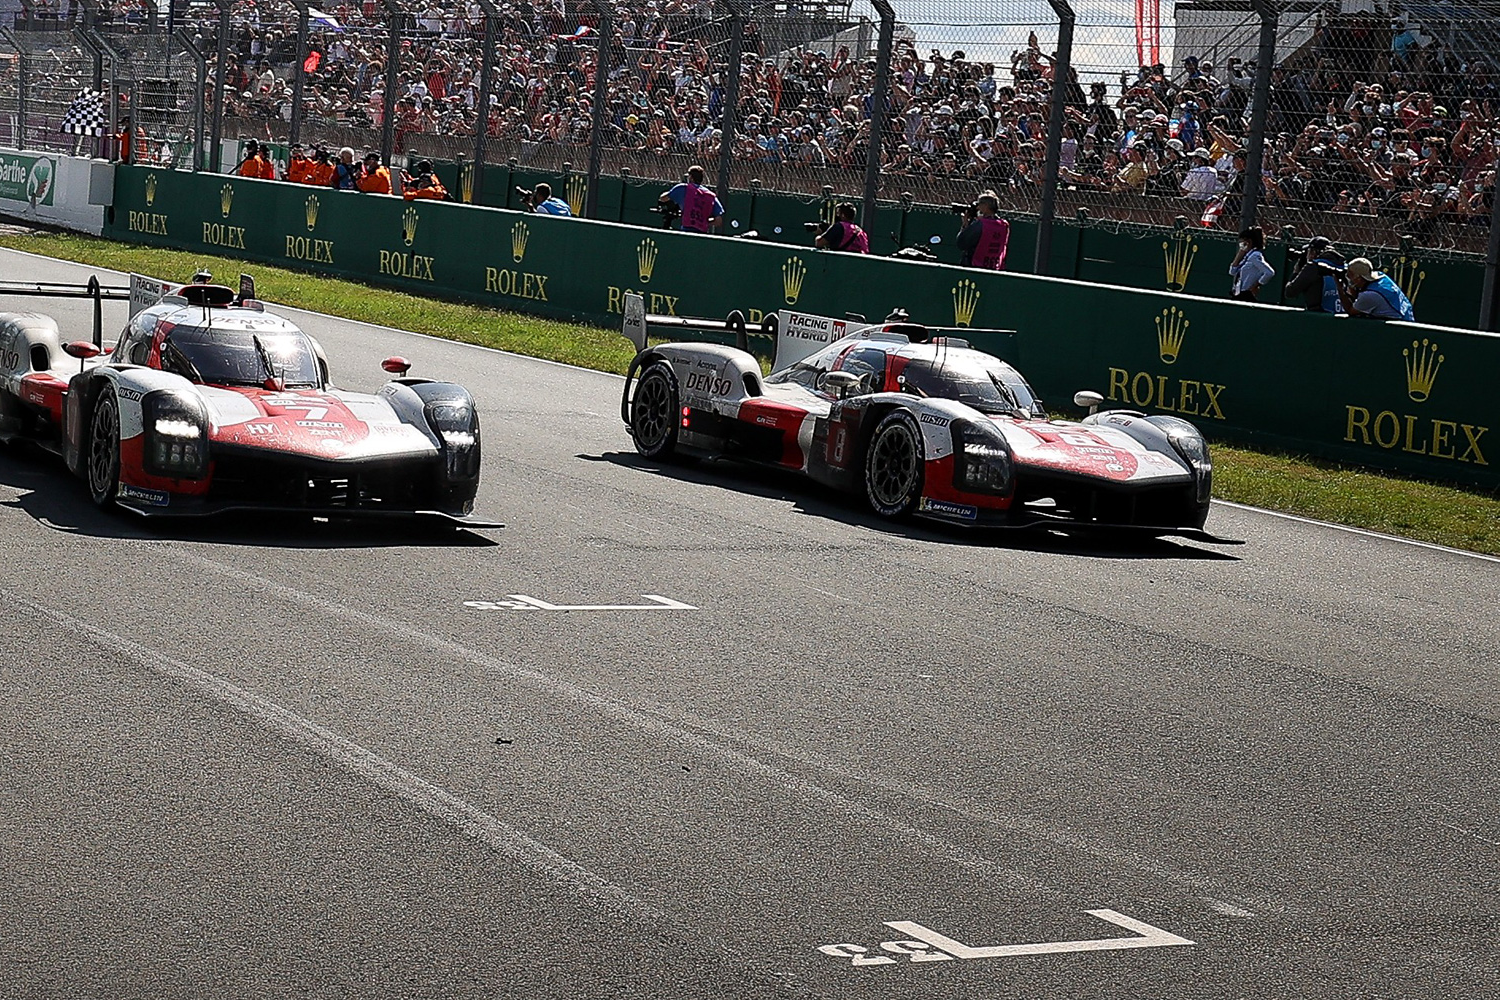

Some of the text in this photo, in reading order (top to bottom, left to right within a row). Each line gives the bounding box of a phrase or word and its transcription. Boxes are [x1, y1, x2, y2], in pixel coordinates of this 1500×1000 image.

[129, 210, 168, 235] ROLEX
[203, 222, 246, 249] ROLEX
[286, 235, 333, 264] ROLEX
[379, 250, 435, 281] ROLEX
[135, 277, 160, 294] RACING
[485, 266, 548, 301] ROLEX
[212, 316, 276, 325] DENSO
[789, 314, 828, 331] RACING
[787, 327, 828, 343] HYBRID
[686, 372, 731, 396] DENSO
[1108, 367, 1226, 420] ROLEX
[285, 406, 329, 419] 7
[250, 423, 275, 435] HY
[1344, 405, 1489, 466] ROLEX
[933, 503, 971, 515] MICHELIN
